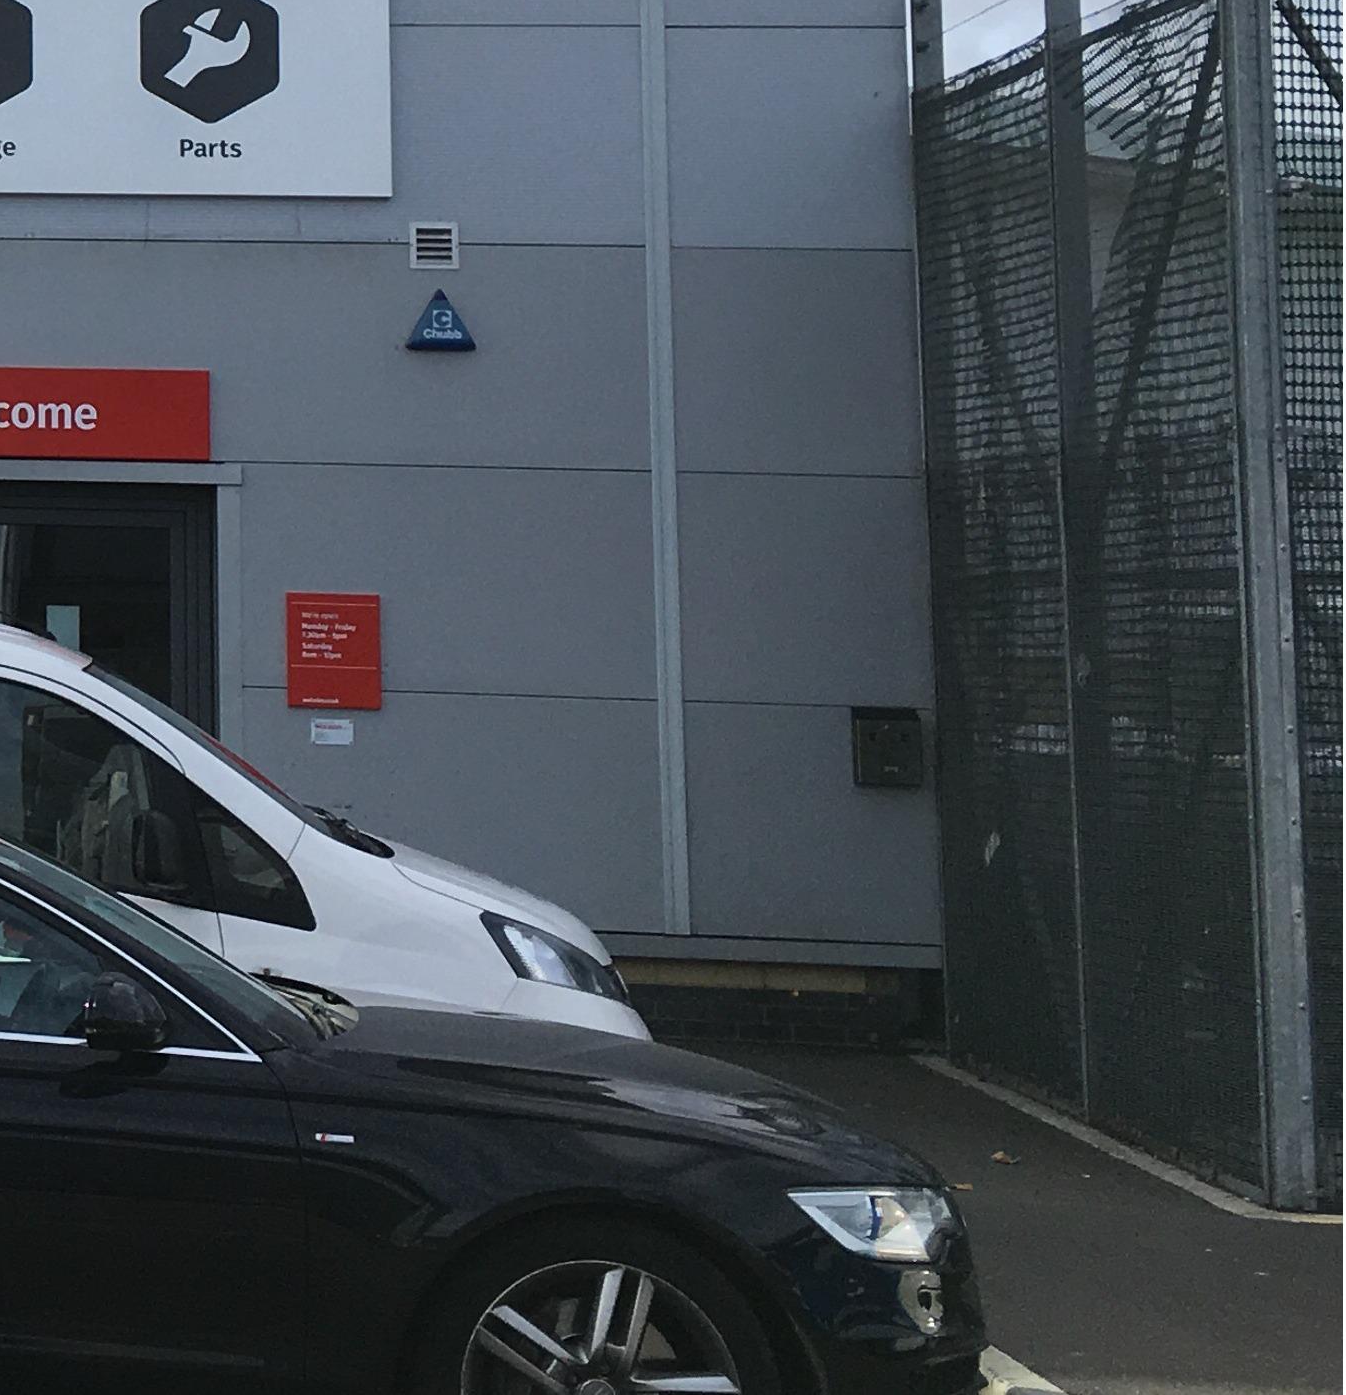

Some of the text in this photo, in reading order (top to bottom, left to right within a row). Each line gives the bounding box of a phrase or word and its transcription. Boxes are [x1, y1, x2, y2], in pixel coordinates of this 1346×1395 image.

[179, 136, 243, 159] Parts
[423, 328, 462, 339] Chubb
[301, 623, 329, 632] Monday
[334, 623, 357, 633] Friday
[301, 642, 333, 651] Saturday
